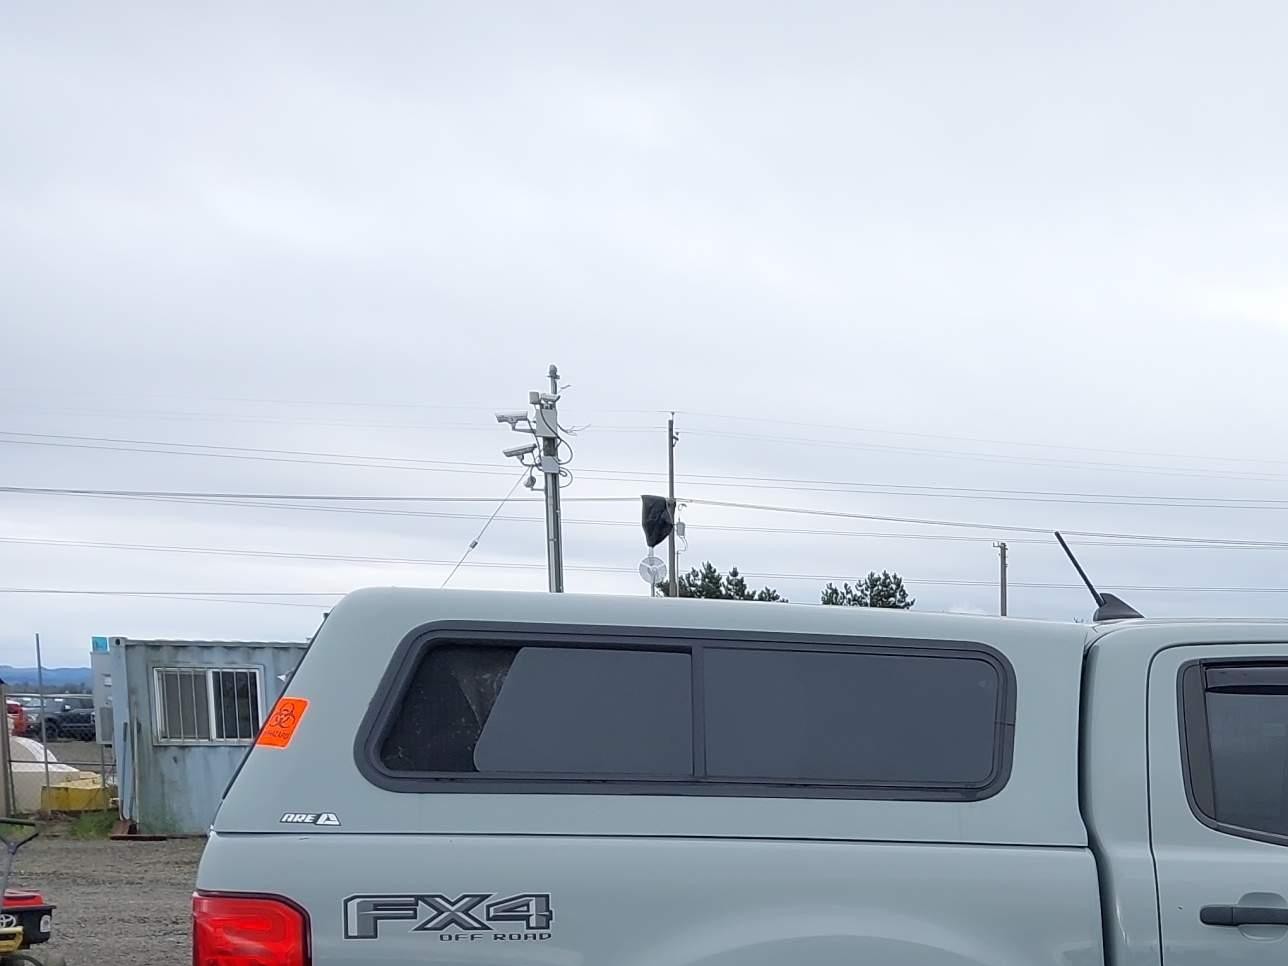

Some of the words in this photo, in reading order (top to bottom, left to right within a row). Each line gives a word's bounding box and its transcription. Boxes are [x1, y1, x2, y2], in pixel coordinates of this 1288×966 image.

[343, 893, 554, 940] FX4
[439, 933, 485, 942] OFF
[493, 932, 553, 942] ROAD
